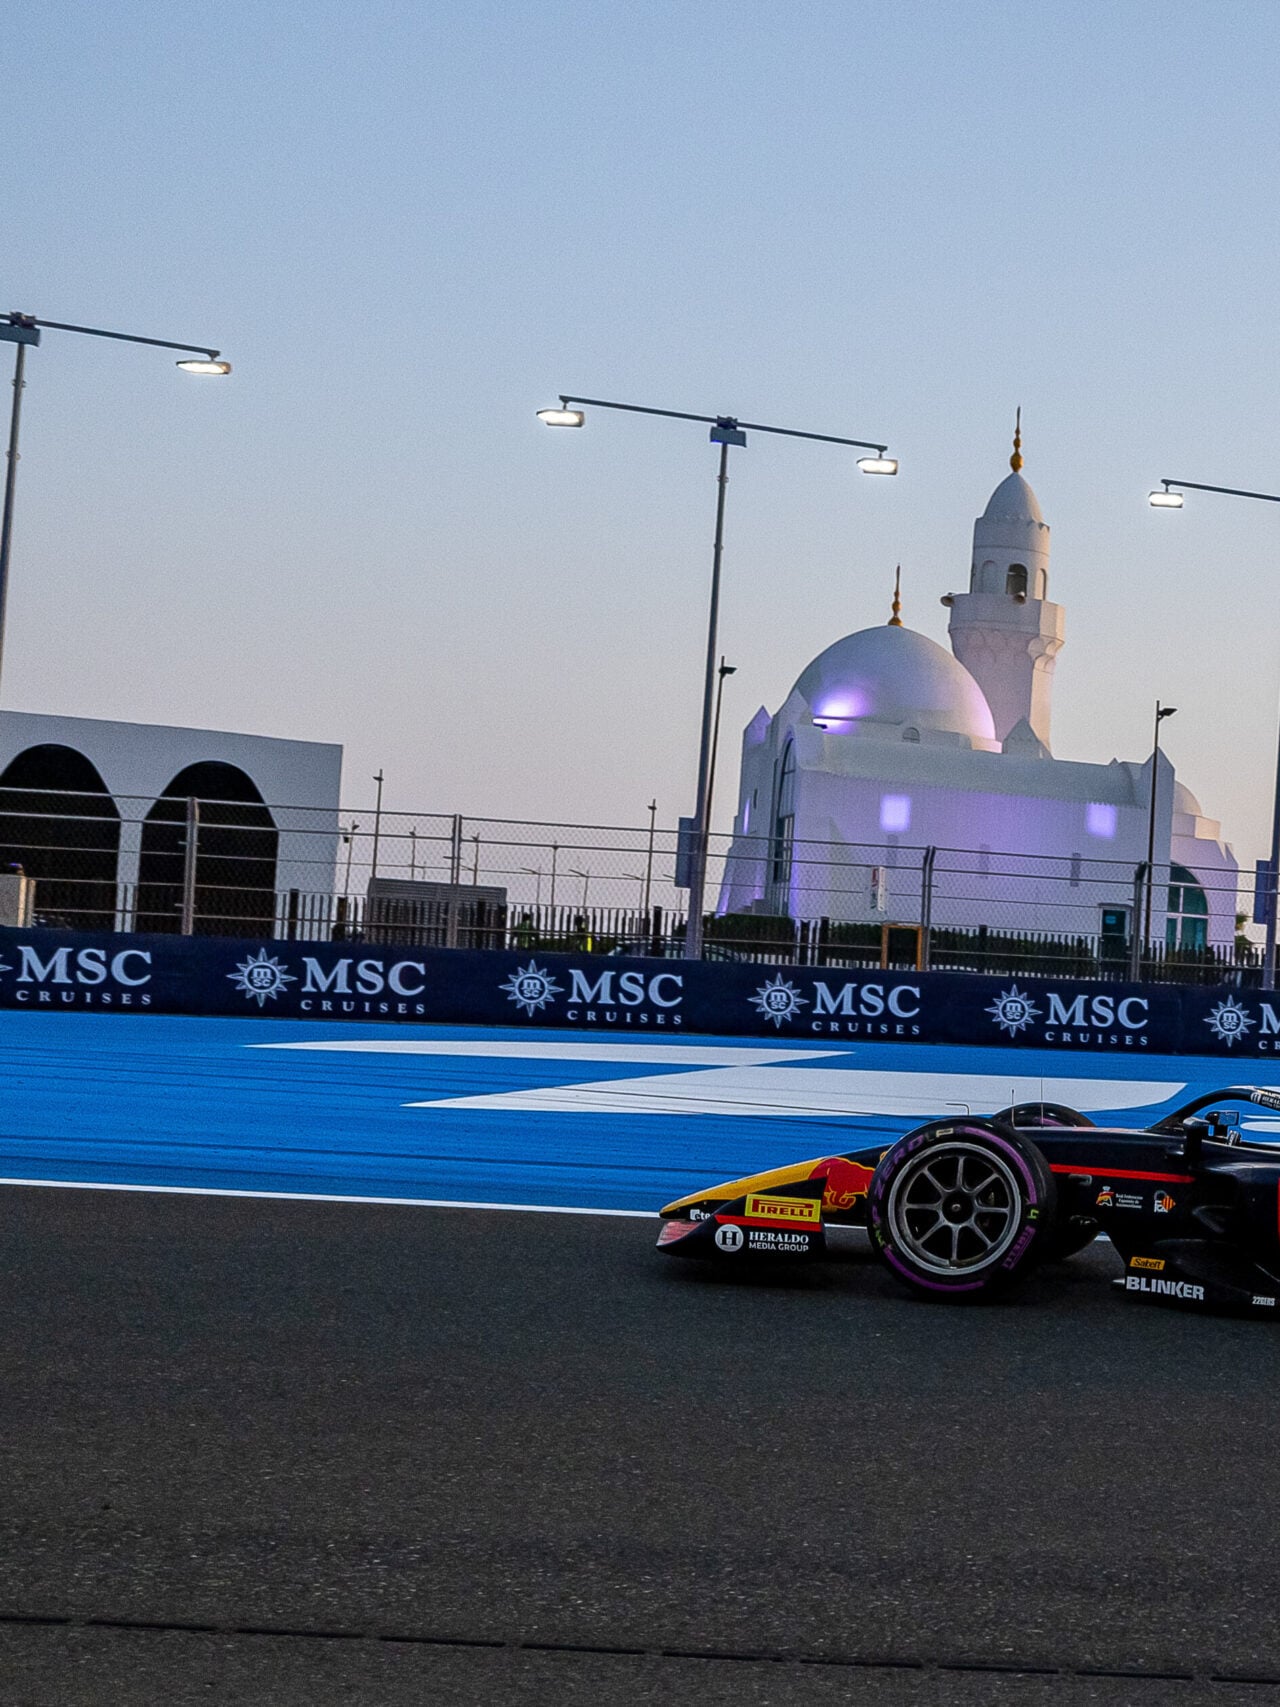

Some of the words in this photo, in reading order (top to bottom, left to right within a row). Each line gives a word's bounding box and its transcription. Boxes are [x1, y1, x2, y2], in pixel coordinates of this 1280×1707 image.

[16, 946, 151, 985] MSC
[301, 958, 425, 995] MSC
[567, 970, 682, 1007] MSC
[16, 991, 150, 1005] CRUISES
[812, 982, 920, 1017] MSC
[301, 1000, 424, 1014] CRUISES
[1045, 993, 1148, 1028] MSC
[567, 1011, 681, 1024] CRUISES
[812, 1022, 920, 1034] CRUISES
[1045, 1032, 1147, 1045] CRUISES
[752, 1198, 814, 1218] PIRELLI
[720, 1230, 740, 1247] H
[748, 1231, 810, 1245] HERALDO
[748, 1241, 777, 1251] MEDIA
[778, 1243, 809, 1253] GROUP
[1126, 1275, 1205, 1300] BLINKER
